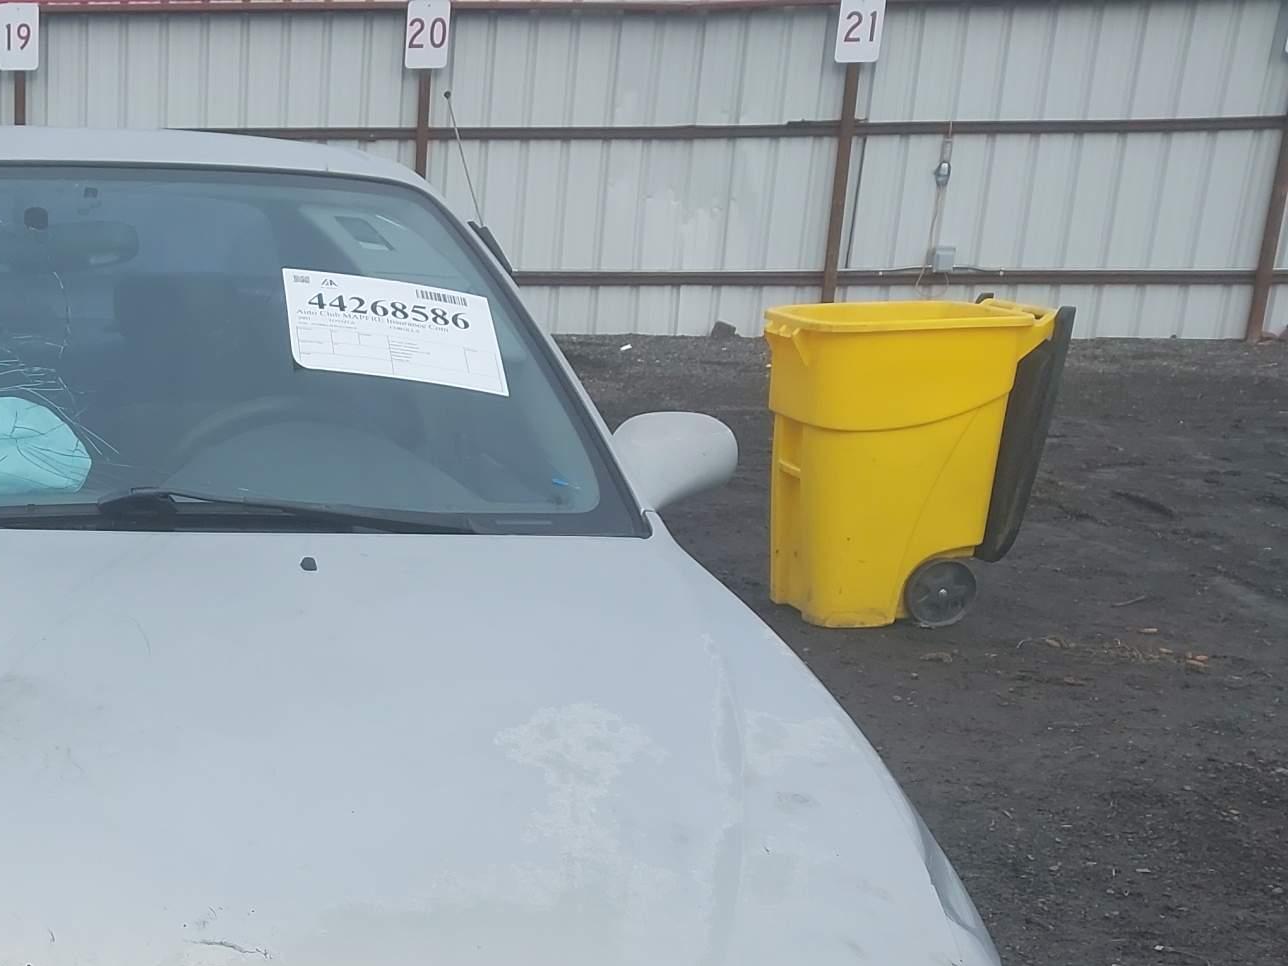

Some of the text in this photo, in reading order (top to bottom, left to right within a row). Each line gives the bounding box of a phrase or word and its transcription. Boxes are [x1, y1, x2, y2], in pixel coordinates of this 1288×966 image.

[5, 22, 31, 51] 19
[408, 17, 447, 49] 20
[843, 10, 877, 43] 21
[307, 292, 470, 330] 44268586
